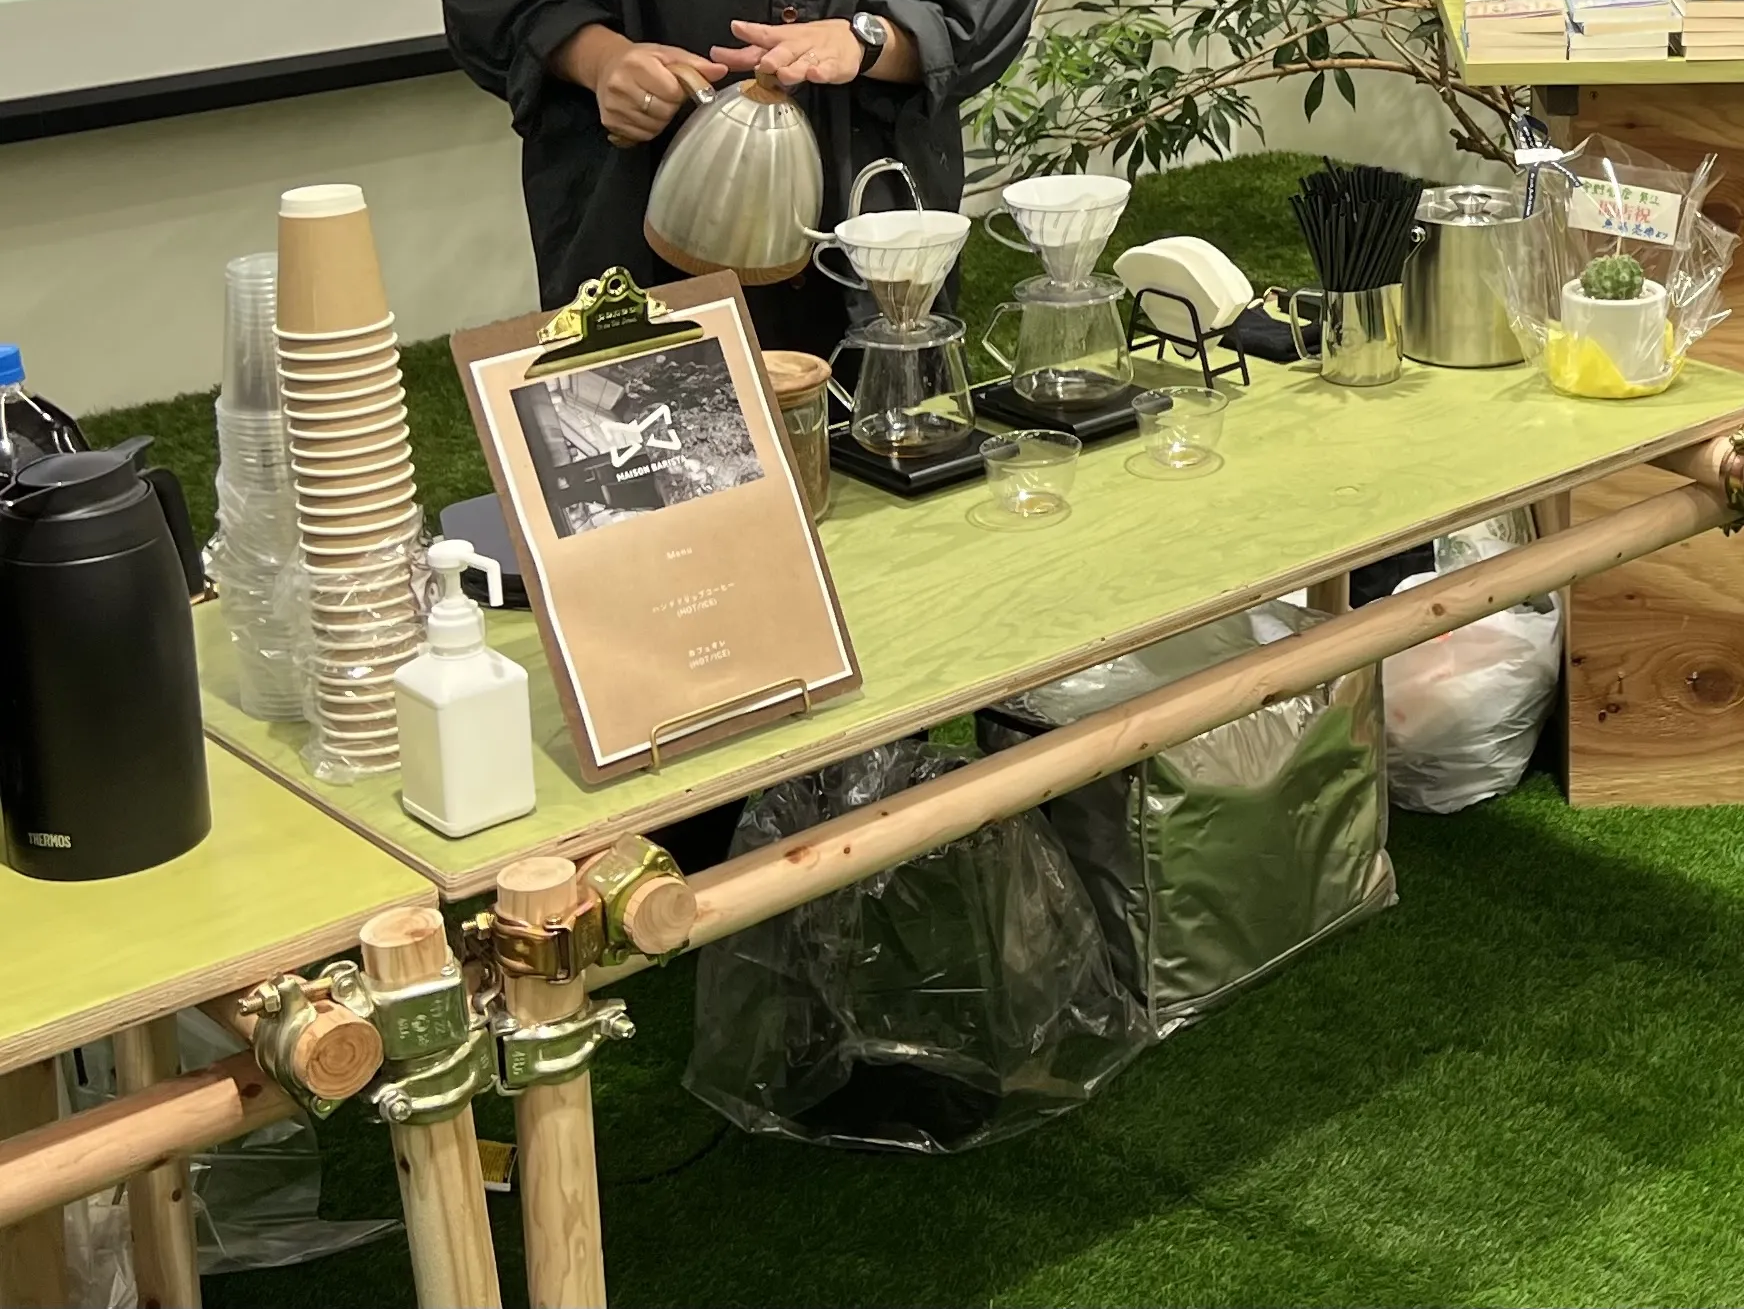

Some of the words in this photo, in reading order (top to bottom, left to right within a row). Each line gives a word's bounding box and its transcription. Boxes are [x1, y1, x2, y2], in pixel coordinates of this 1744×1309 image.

[616, 465, 651, 482] MAISON
[650, 455, 687, 472] BARISTA
[666, 547, 692, 560] Menu
[28, 832, 72, 849] THERMOS
